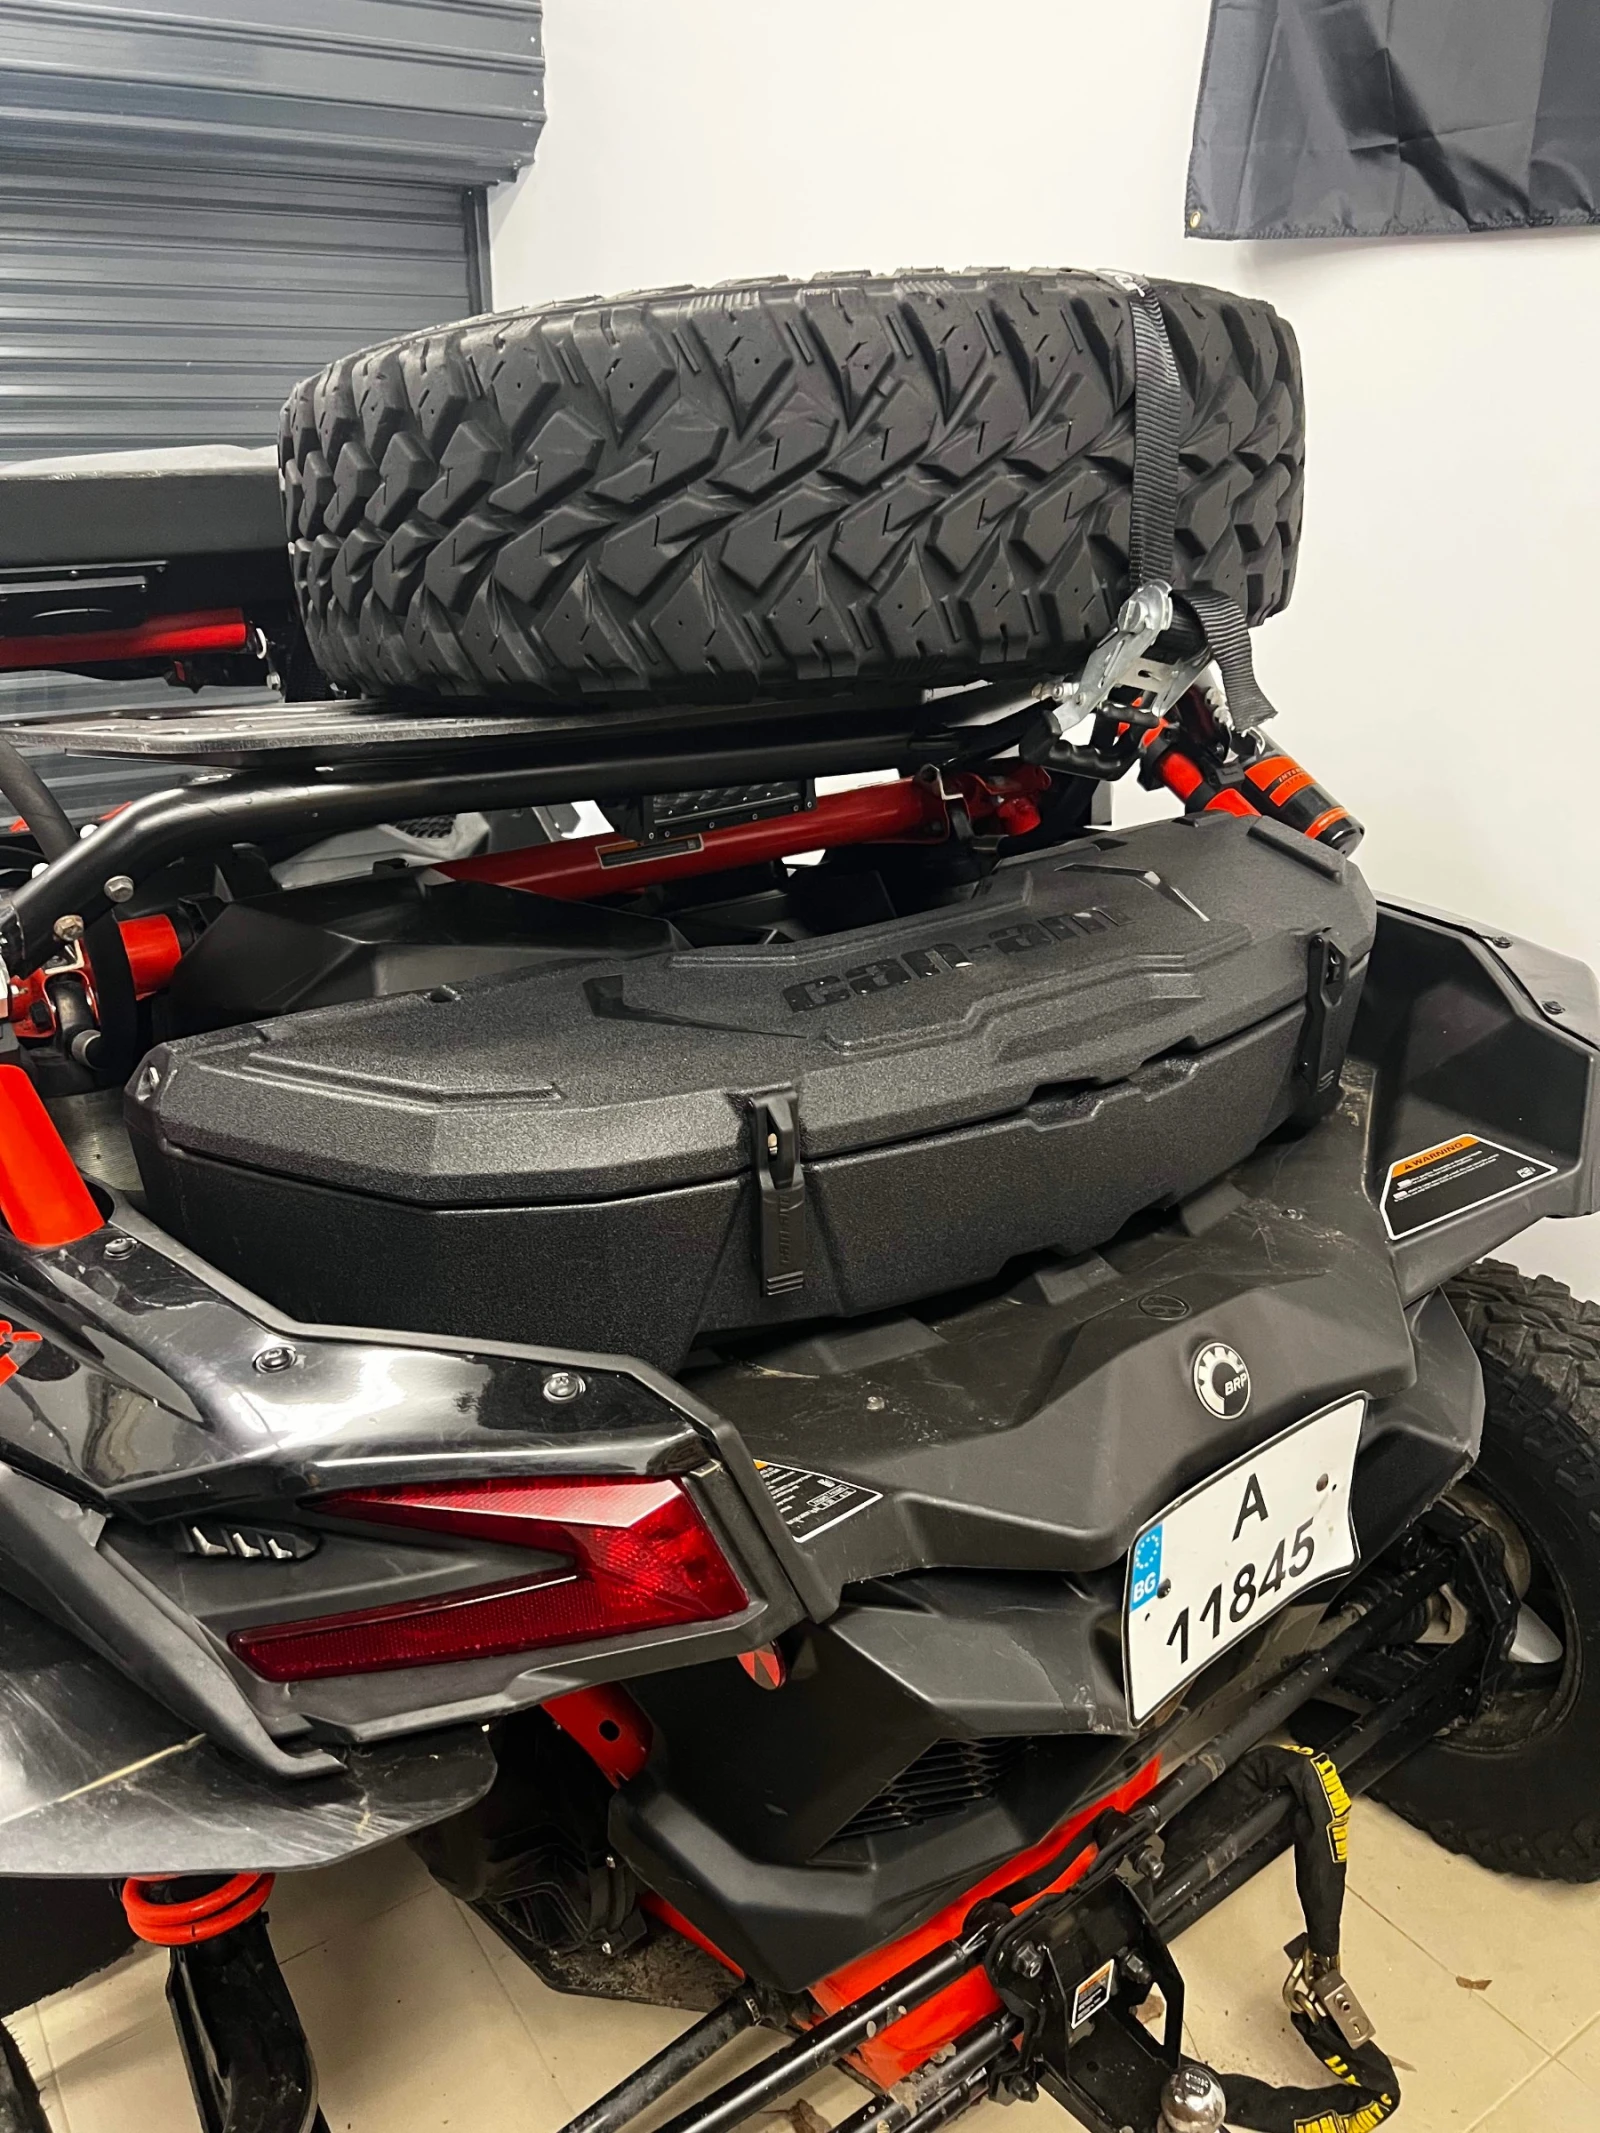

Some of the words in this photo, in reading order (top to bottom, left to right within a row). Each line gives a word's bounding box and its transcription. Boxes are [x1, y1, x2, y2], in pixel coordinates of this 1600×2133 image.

[781, 906, 1136, 1013] can-am
[1412, 1142, 1463, 1166] WARNING
[1225, 1372, 1247, 1396] BRP
[1232, 1473, 1269, 1541] A
[1133, 1570, 1157, 1603] BG
[1166, 1517, 1315, 1665] 11845
